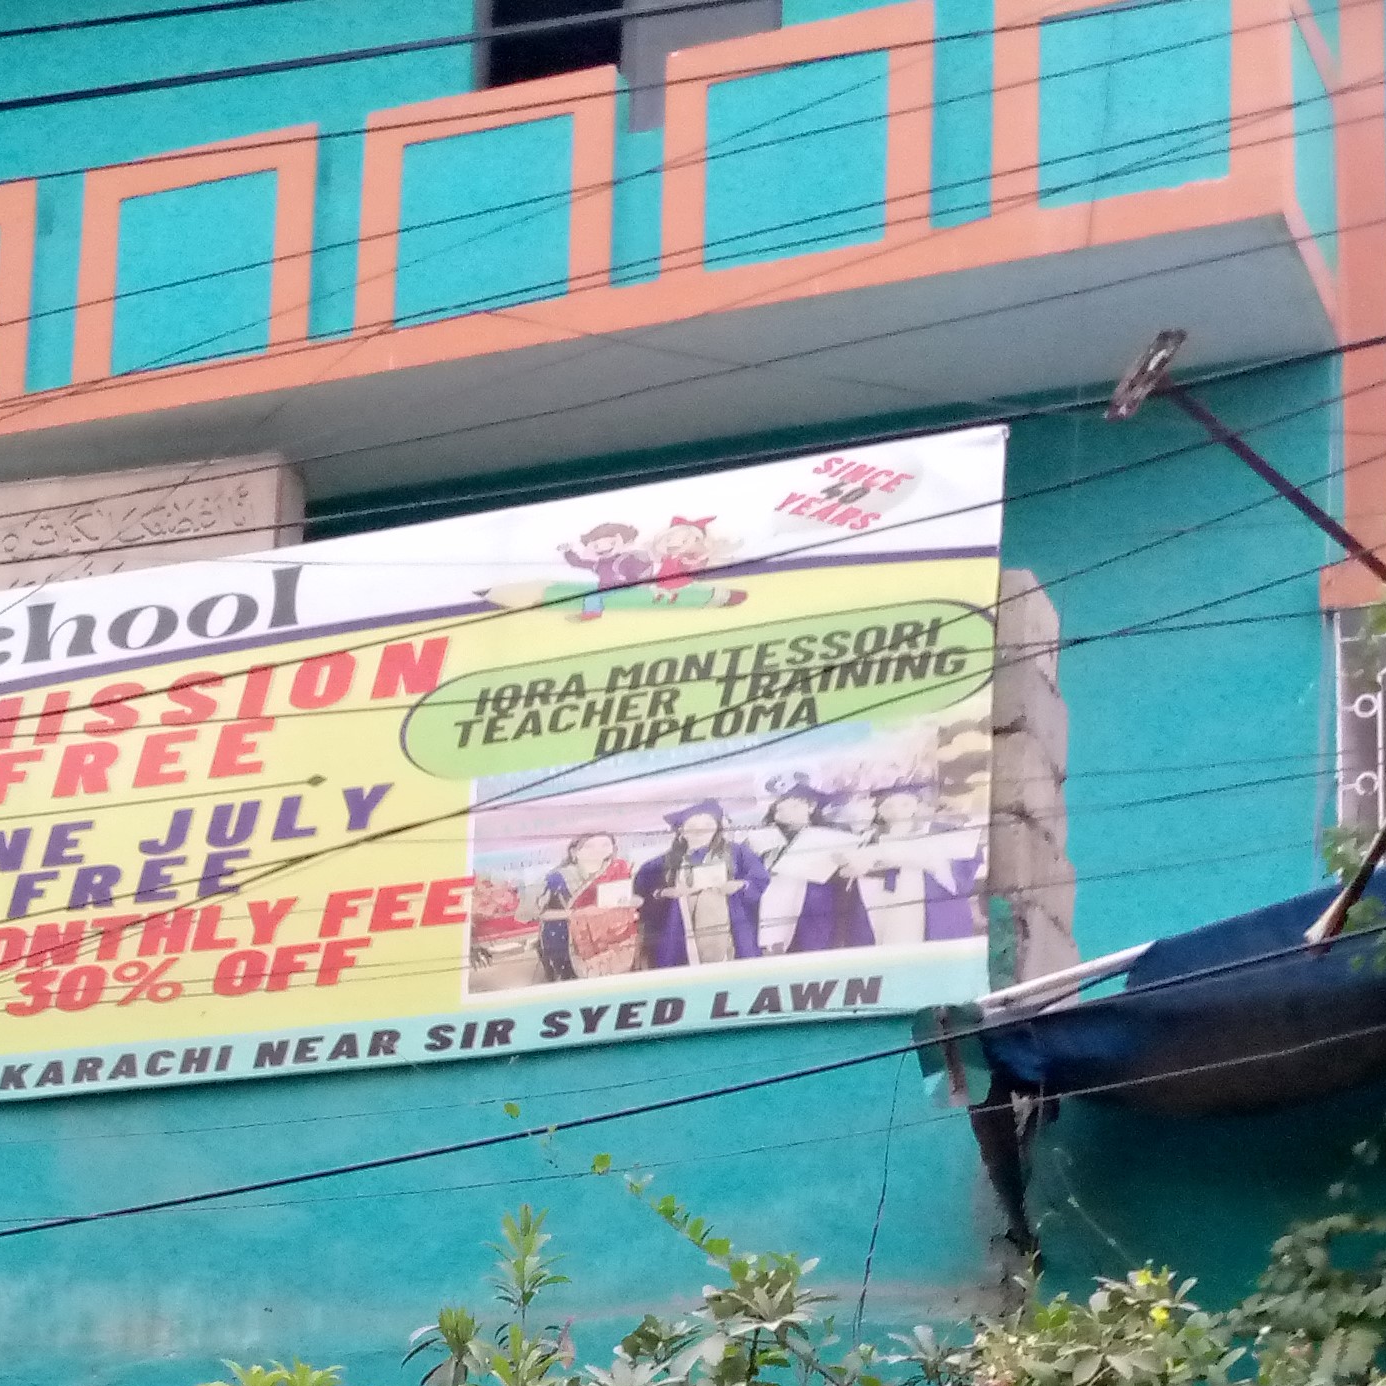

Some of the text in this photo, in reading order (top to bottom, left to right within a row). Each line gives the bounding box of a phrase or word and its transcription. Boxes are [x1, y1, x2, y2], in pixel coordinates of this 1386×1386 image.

[813, 457, 915, 493] SINCE
[774, 492, 881, 530] YEARS
[454, 645, 969, 749] TEACHER TRAINING
[474, 616, 944, 717] IQRA MONTESSORI
[593, 697, 818, 760] DIPLOMA
[138, 783, 395, 855] JULY
[7, 849, 250, 920] FREE
[318, 876, 476, 940] FEE
[5, 937, 371, 1017] 30% OFF
[254, 1030, 401, 1067] NEAR
[424, 1016, 514, 1051] SIR
[539, 997, 686, 1040] SYED
[710, 976, 882, 1018] LAWN
